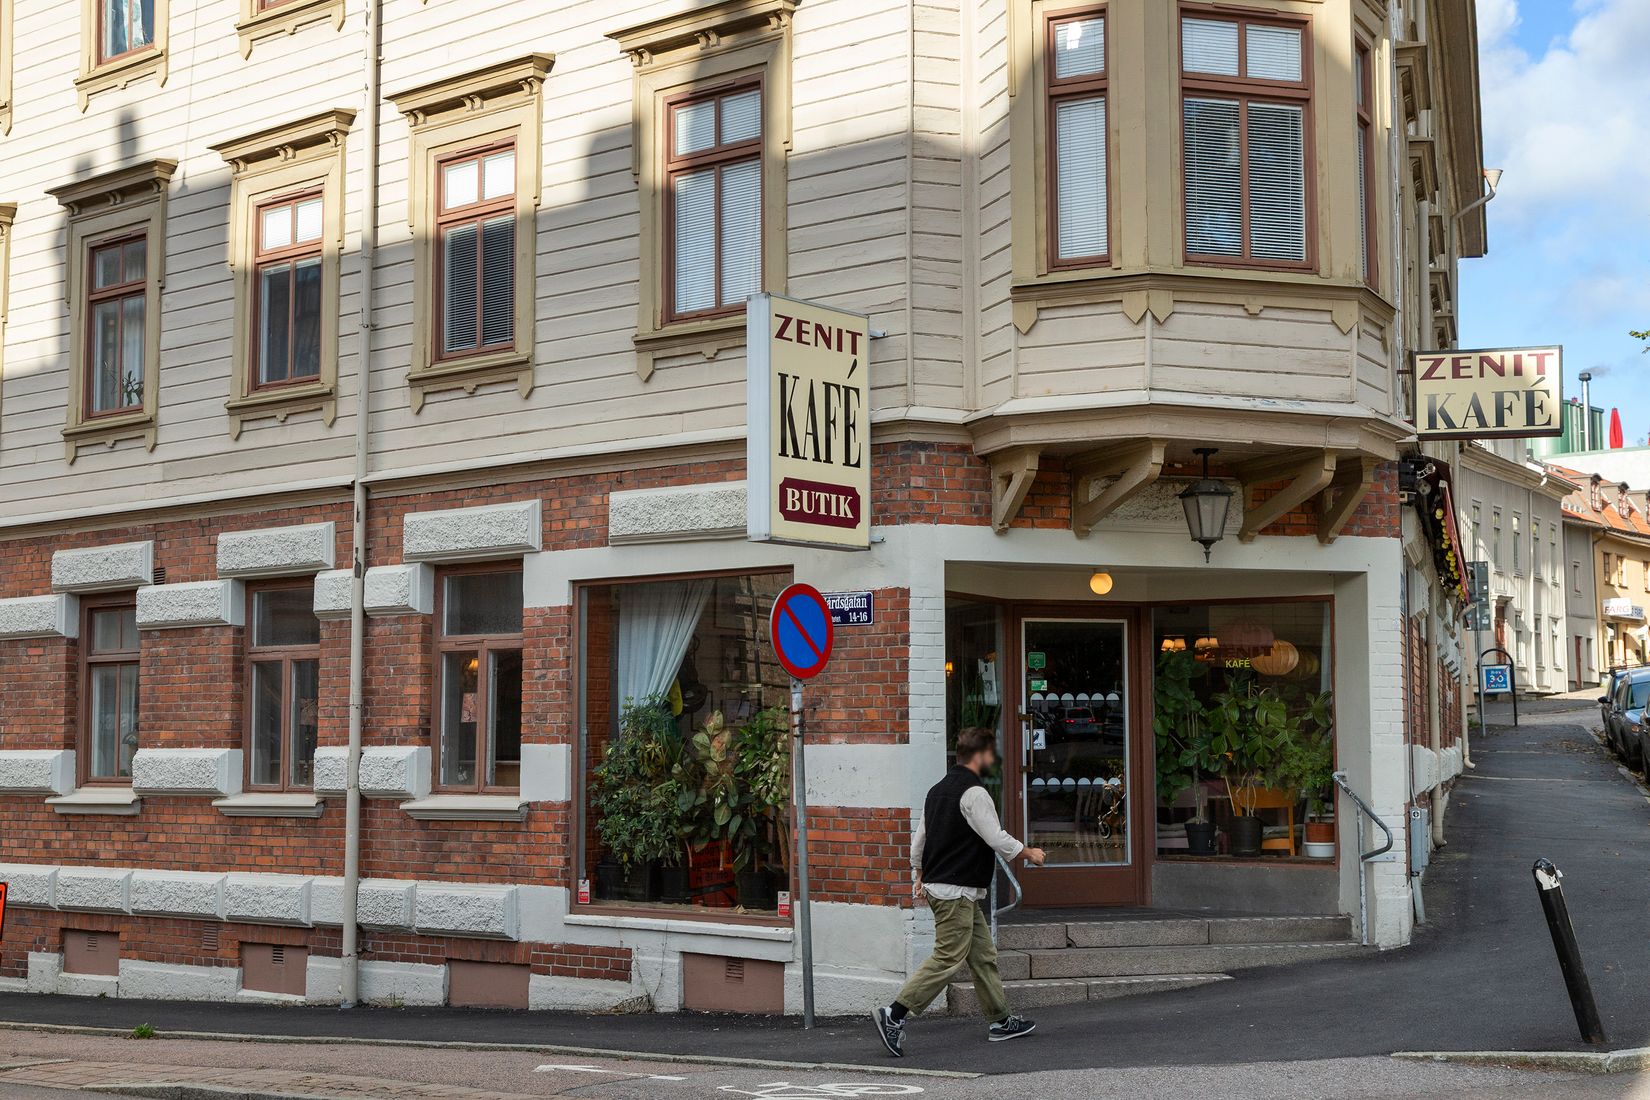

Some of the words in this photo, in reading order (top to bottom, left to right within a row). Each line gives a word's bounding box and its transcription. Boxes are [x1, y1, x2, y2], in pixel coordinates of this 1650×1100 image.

[774, 313, 863, 356] ZENIT
[1419, 353, 1553, 380] ZENIT
[777, 358, 861, 468] KAFÉ
[1423, 376, 1552, 430] KAFÉ
[785, 487, 854, 519] BUTIK
[825, 596, 867, 611] årdsgatan
[849, 612, 867, 622] 14-16
[1226, 658, 1250, 668] KAFÉ
